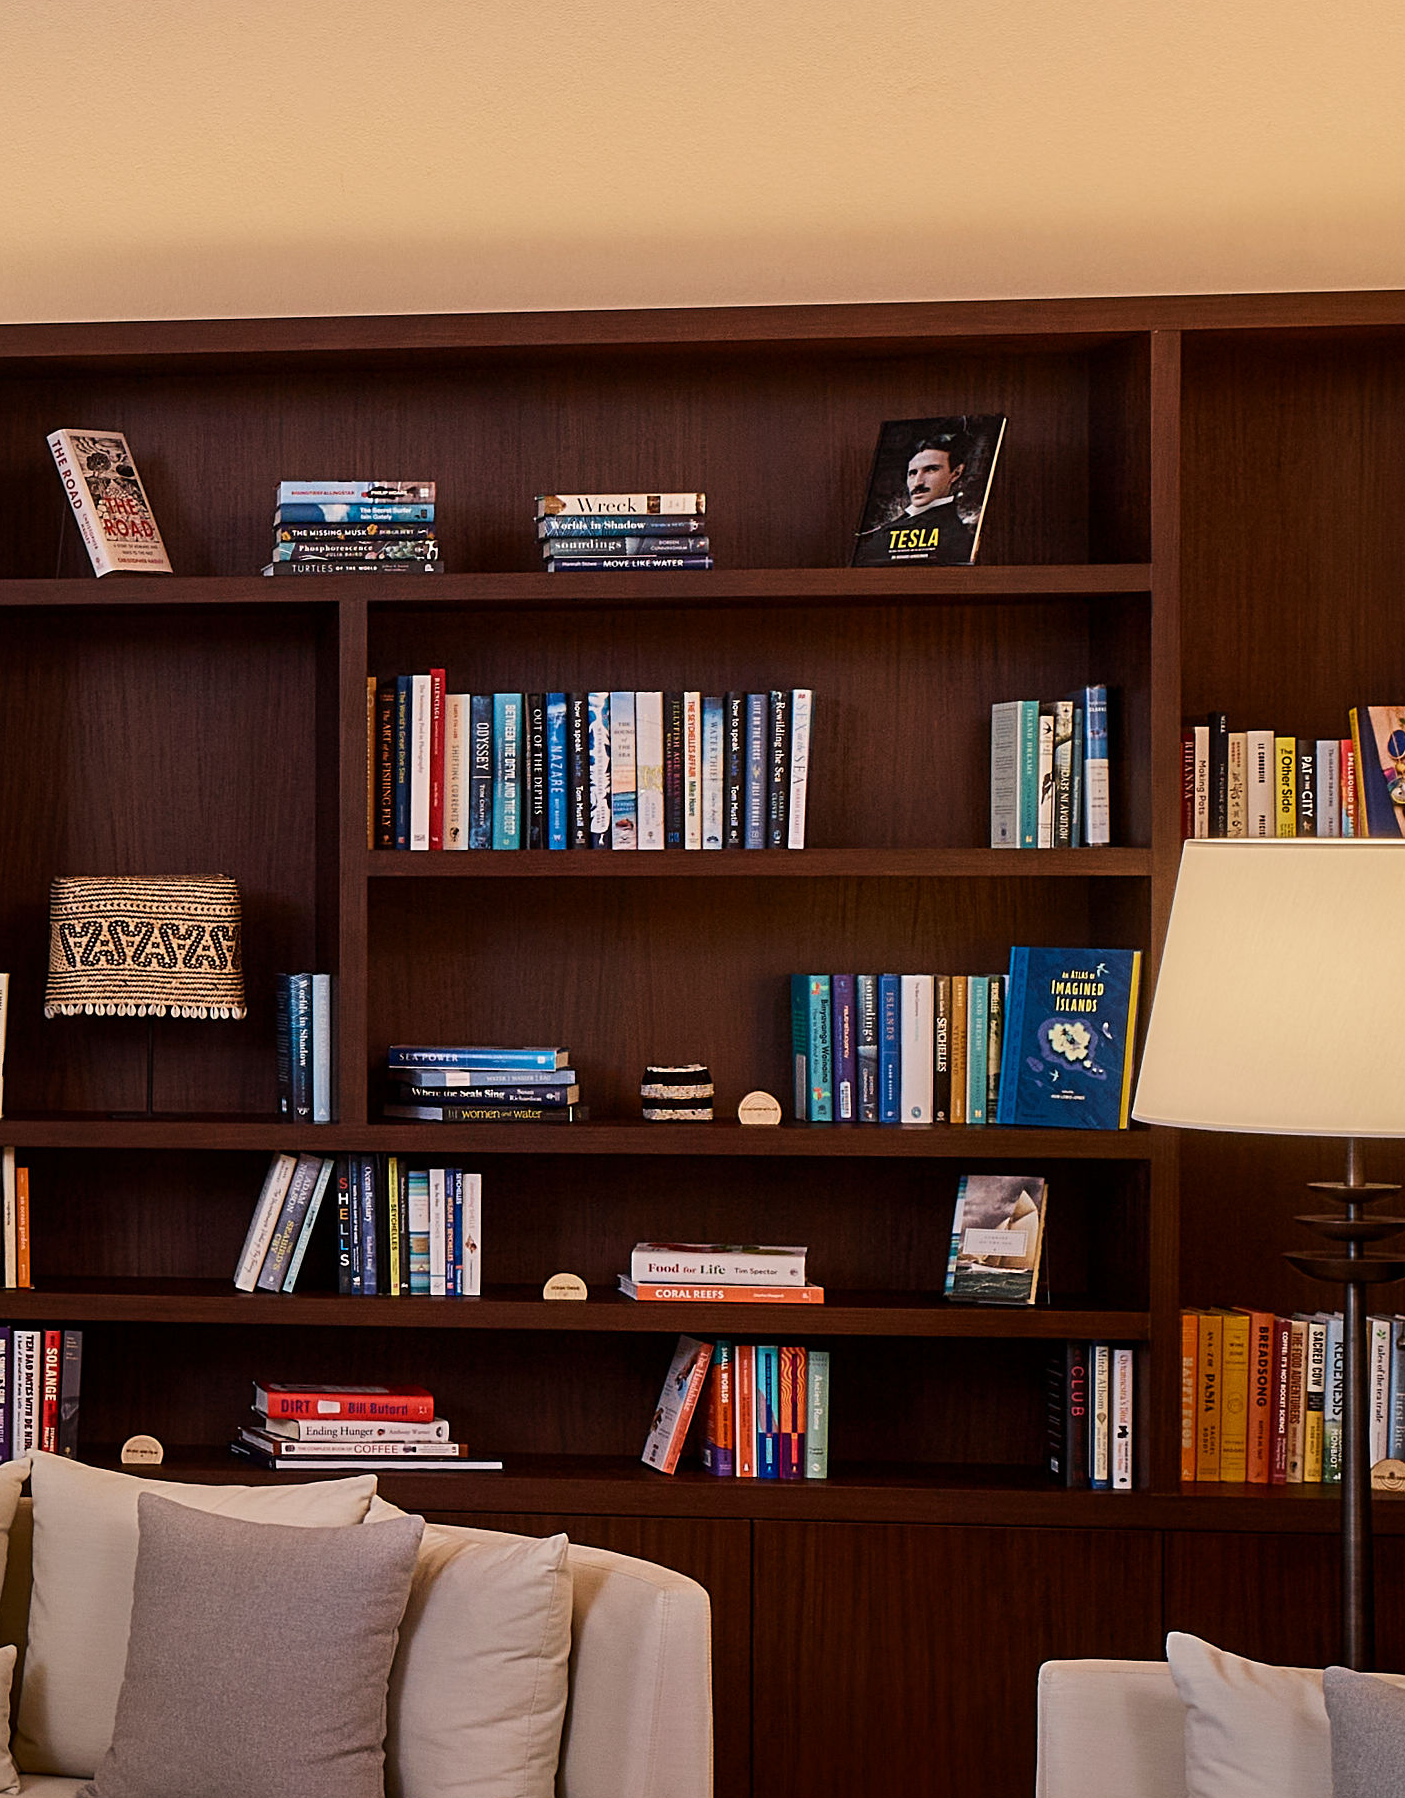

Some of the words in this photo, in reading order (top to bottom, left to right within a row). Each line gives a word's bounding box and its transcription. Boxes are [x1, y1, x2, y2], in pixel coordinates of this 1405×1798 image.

[52, 439, 67, 464] THE
[62, 468, 83, 510] ROAD
[104, 498, 137, 516] THE
[576, 497, 637, 513] Wreck
[104, 518, 153, 538] ROAD
[551, 520, 588, 532] Worlds
[591, 520, 600, 531] in
[603, 520, 645, 532] Shadow
[299, 544, 373, 555] Phosphorescence
[888, 529, 939, 550] TESLA
[603, 559, 629, 567] MOVE
[632, 559, 650, 567] LIKE
[652, 558, 683, 567] WATER
[534, 708, 543, 731] OUT
[476, 722, 490, 771] ODYSSEY
[534, 734, 543, 749] OF
[533, 752, 543, 774] THE
[1184, 741, 1194, 799] RIHANNA
[1281, 757, 1292, 788] Other
[1302, 756, 1312, 775] PAT
[1197, 760, 1206, 792] Making
[534, 777, 543, 815] DEPTHS
[1198, 795, 1206, 815] Pots
[1281, 790, 1292, 814] Side
[1302, 791, 1313, 817] CITY
[1051, 980, 1104, 996] IMAGINED
[1055, 997, 1098, 1013] ISLANDS
[938, 1018, 947, 1072] SEYCHELLES
[399, 1052, 420, 1062] SEA
[422, 1053, 458, 1062] POWER
[338, 1177, 350, 1266] SHELLS
[648, 1262, 679, 1275] Food
[683, 1265, 696, 1274] for
[700, 1262, 726, 1276] Life
[735, 1266, 748, 1275] Tim
[750, 1267, 778, 1277] Spector
[655, 1289, 691, 1299] CORAL
[693, 1289, 724, 1299] REEFS
[1313, 1331, 1323, 1365] SACRED
[45, 1348, 57, 1401] SOLANGE
[1257, 1326, 1269, 1407] BREADSONG
[1312, 1368, 1323, 1386] COW
[1071, 1366, 1085, 1417] CLUB
[1204, 1374, 1214, 1413] PASTA
[281, 1399, 311, 1414] DIRT
[348, 1402, 366, 1414] Bill
[306, 1426, 338, 1438] Ending
[340, 1426, 374, 1438] Hunger
[355, 1444, 399, 1454] COFFEE
